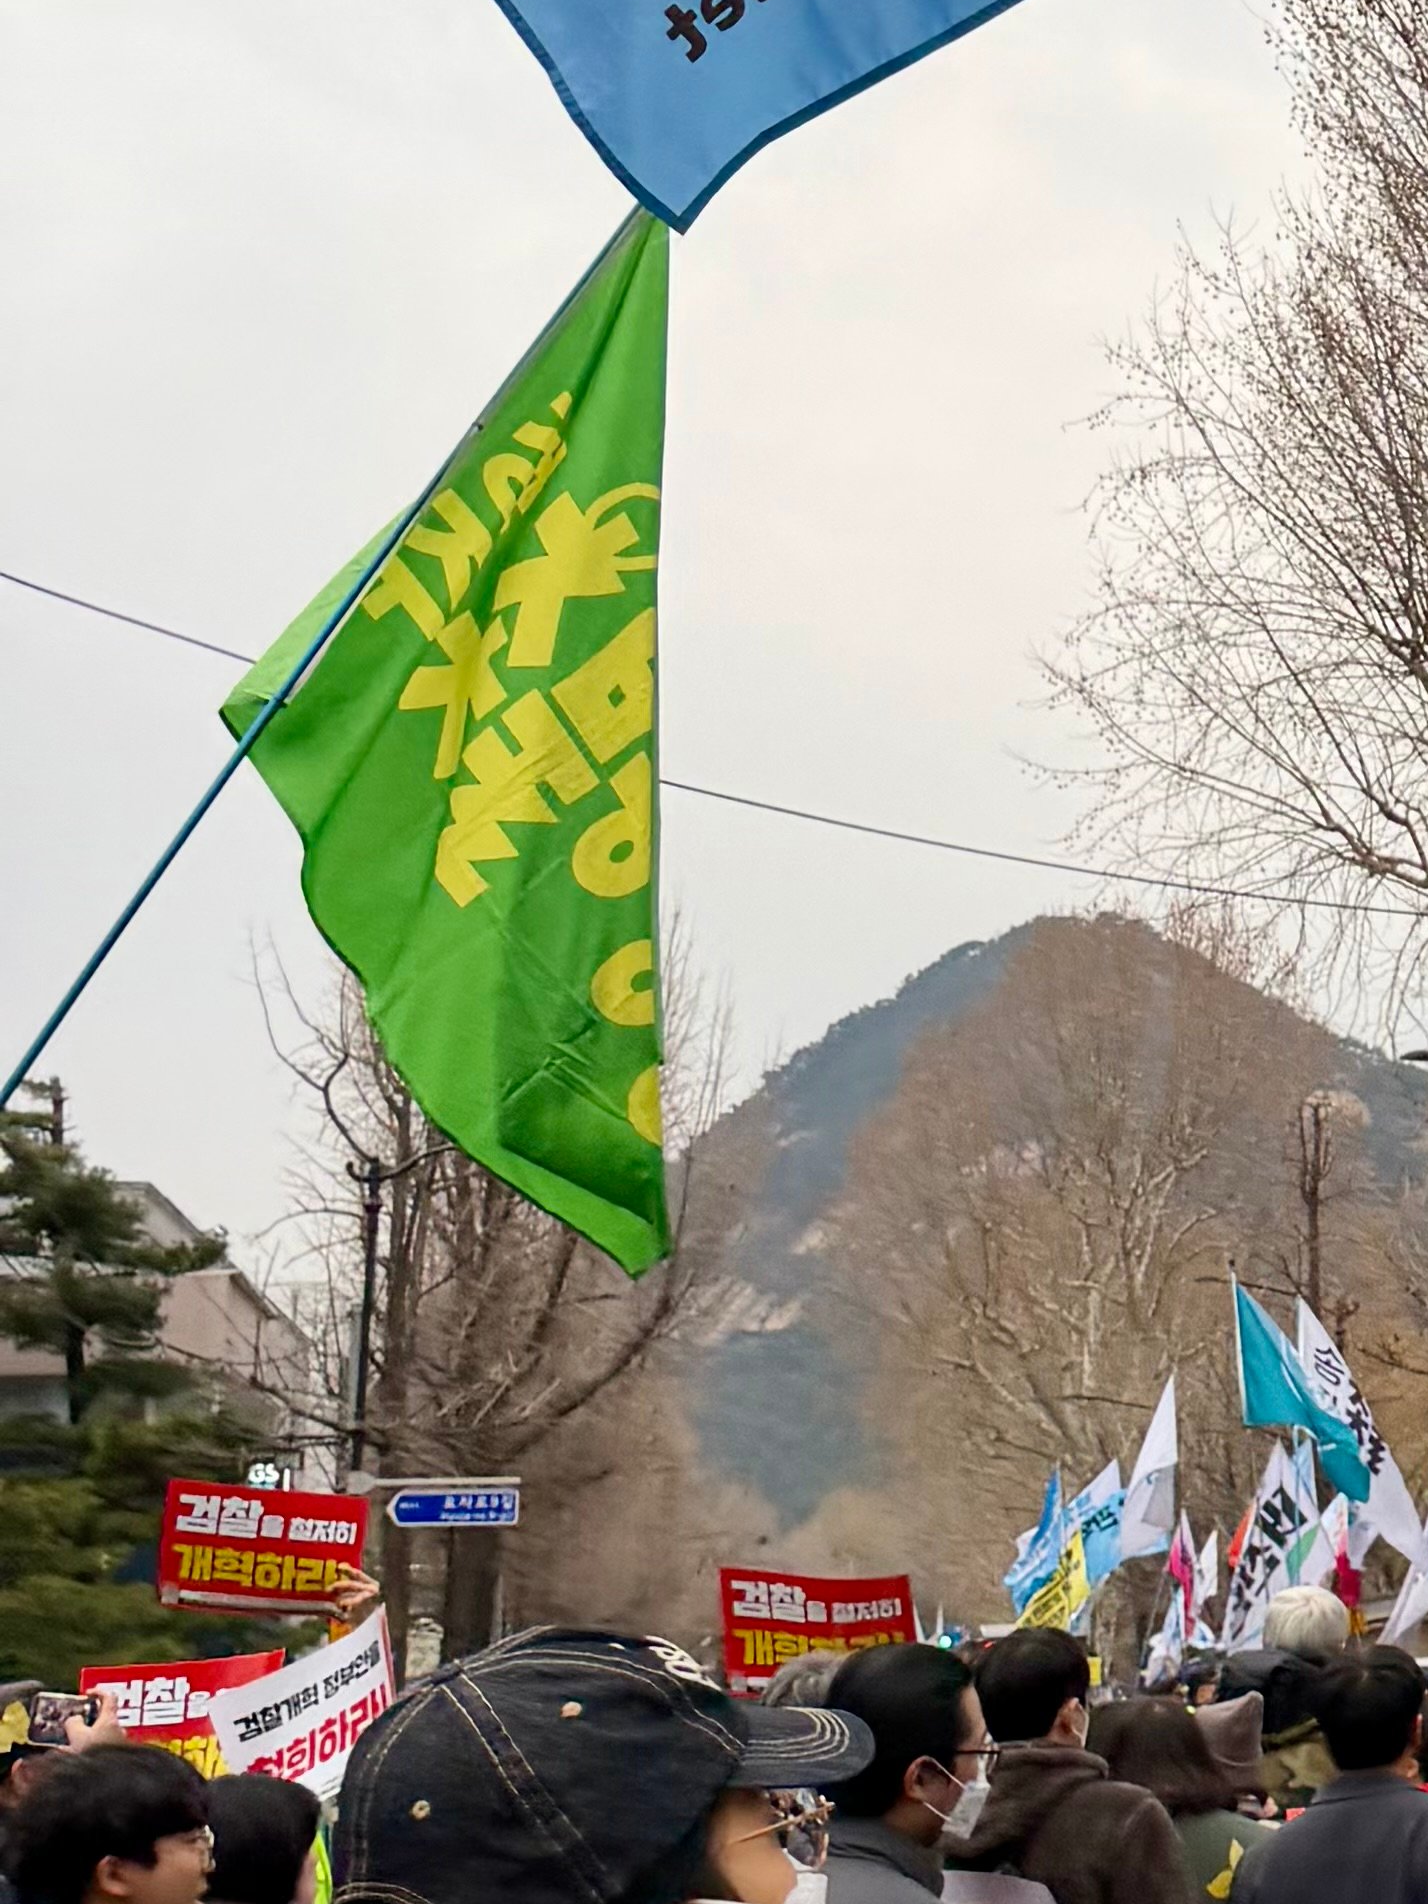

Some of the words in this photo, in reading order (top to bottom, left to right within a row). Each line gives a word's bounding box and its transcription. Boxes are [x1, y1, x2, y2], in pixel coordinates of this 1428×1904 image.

[249, 1463, 280, 1483] GS
[175, 1494, 285, 1539] 검찰을
[730, 1579, 828, 1624] 검찰을
[233, 1683, 320, 1743] 검찰개혁
